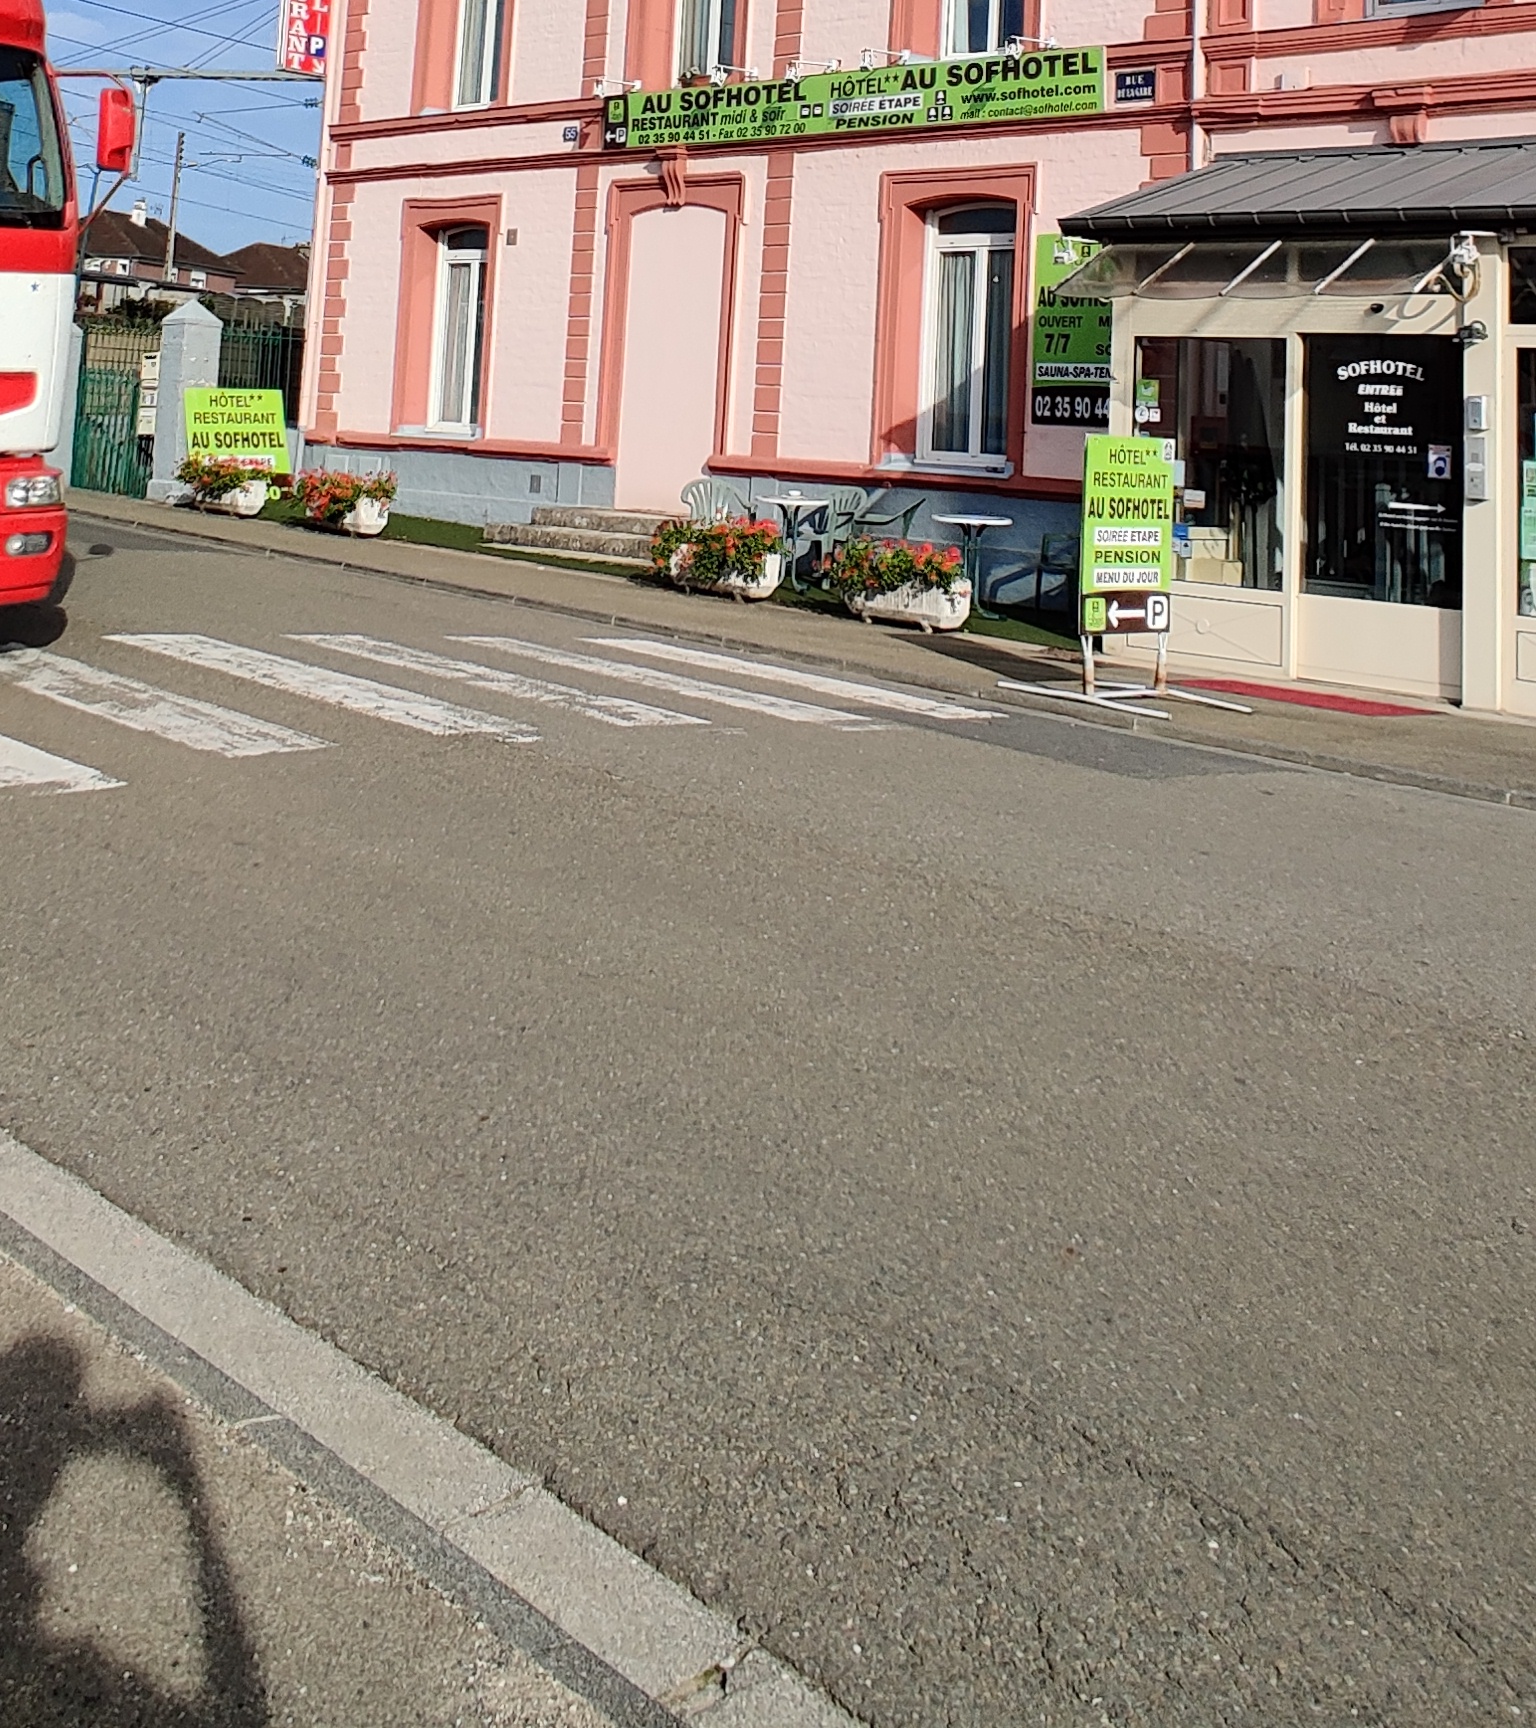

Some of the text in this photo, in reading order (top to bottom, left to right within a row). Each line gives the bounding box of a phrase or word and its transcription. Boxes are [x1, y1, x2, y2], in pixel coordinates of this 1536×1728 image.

[310, 37, 324, 55] P
[830, 52, 1097, 98] HÔTEL AU SOFHOTEL
[1125, 74, 1144, 85] RUE
[640, 82, 807, 115] AU SOFHOTEL
[960, 83, 1096, 104] www.sofhotel.com
[631, 111, 719, 132] RESTAURANT
[720, 109, 747, 126] midi
[749, 110, 758, 123] &
[762, 106, 786, 122] soir
[960, 109, 980, 120] mail
[988, 100, 1097, 118] contact@sofhotel.com
[835, 112, 915, 129] PENSION
[638, 134, 650, 145] 02
[653, 132, 666, 144] 35
[668, 132, 680, 143] 90
[683, 131, 695, 141] 44
[699, 130, 710, 140] 51
[719, 128, 734, 139] Fax
[737, 126, 748, 137] 02
[750, 125, 763, 137] 35
[765, 125, 777, 136] 90
[780, 124, 791, 134] 72
[793, 122, 806, 133] 00
[1038, 315, 1083, 328] OUVERT
[1044, 333, 1071, 355] 7/7
[1336, 359, 1425, 382] SOFHOTEL
[209, 392, 251, 408] HÔTEL
[1035, 395, 1051, 417] 02
[1055, 396, 1071, 418] 35
[1074, 396, 1091, 419] 90
[1364, 402, 1397, 414] Hôtel
[194, 412, 277, 425] RESTAURANT
[1374, 415, 1386, 424] et
[1348, 422, 1413, 436] Restaurant
[192, 431, 284, 449] AU SOFHOTEL
[1361, 444, 1370, 452] 02
[1384, 444, 1394, 453] 90
[1396, 445, 1406, 454] 44
[1109, 444, 1146, 465] HÔTEL
[1093, 471, 1168, 489] RESTAURANT
[1087, 497, 1170, 520] AU SOFHOTEL
[1094, 550, 1161, 564] PENSION
[1096, 570, 1159, 584] MENU DU JOUR
[1152, 601, 1164, 626] P
